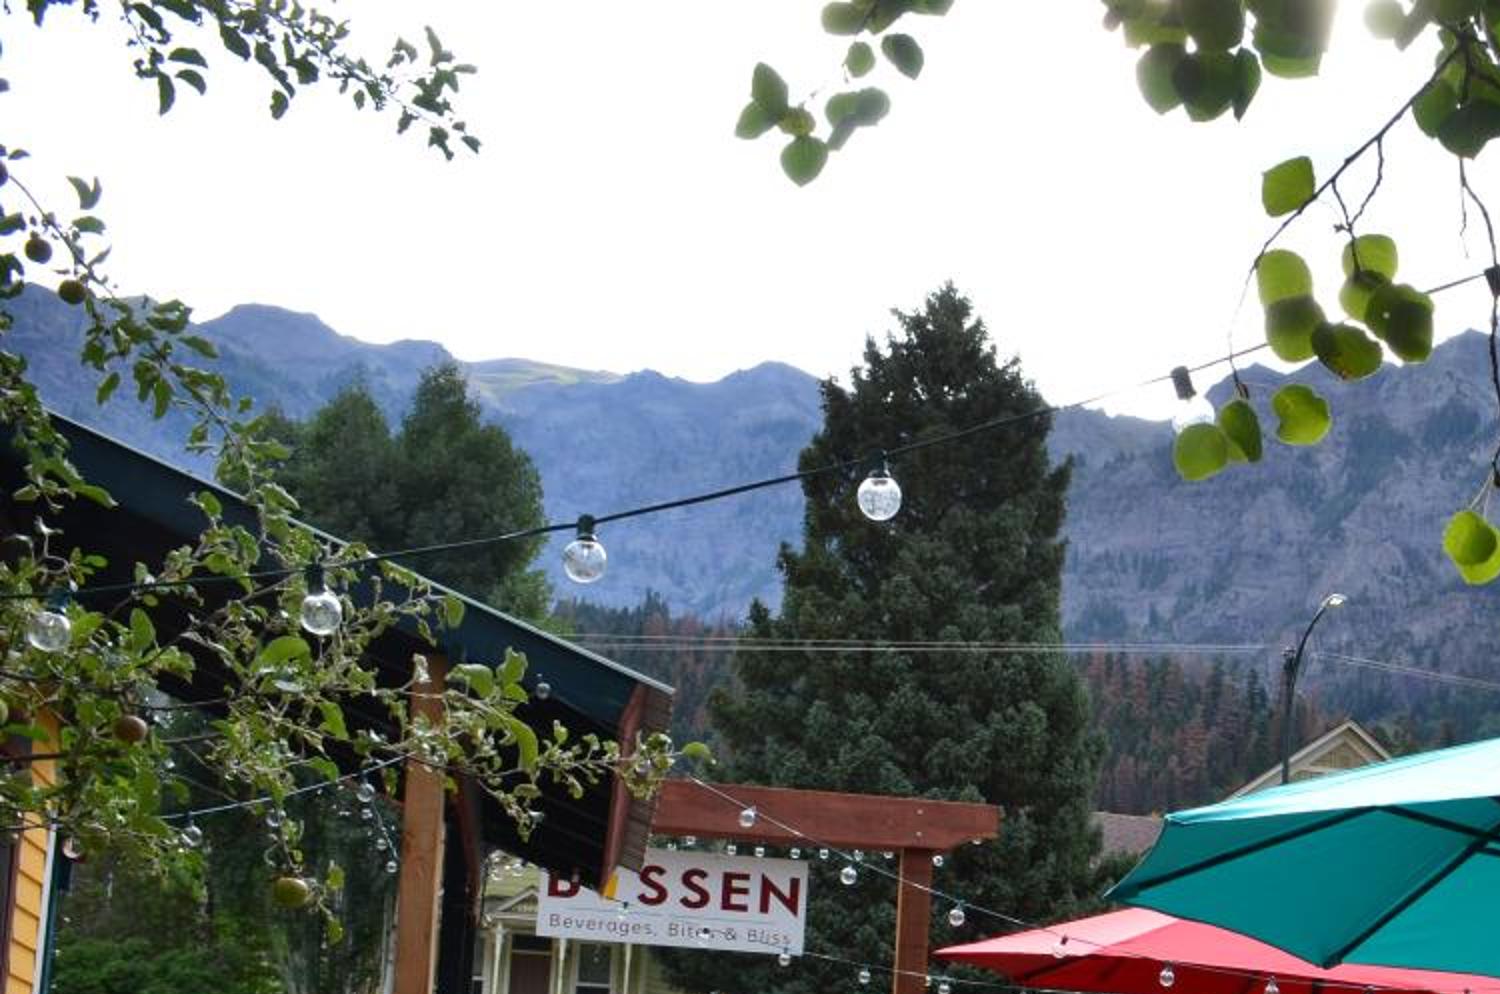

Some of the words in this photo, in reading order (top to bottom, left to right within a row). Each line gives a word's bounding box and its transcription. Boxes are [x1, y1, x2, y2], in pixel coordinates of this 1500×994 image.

[547, 865, 800, 918] SSEN
[549, 913, 657, 937] Beverages,
[668, 922, 715, 939] Bit
[725, 927, 737, 941] &
